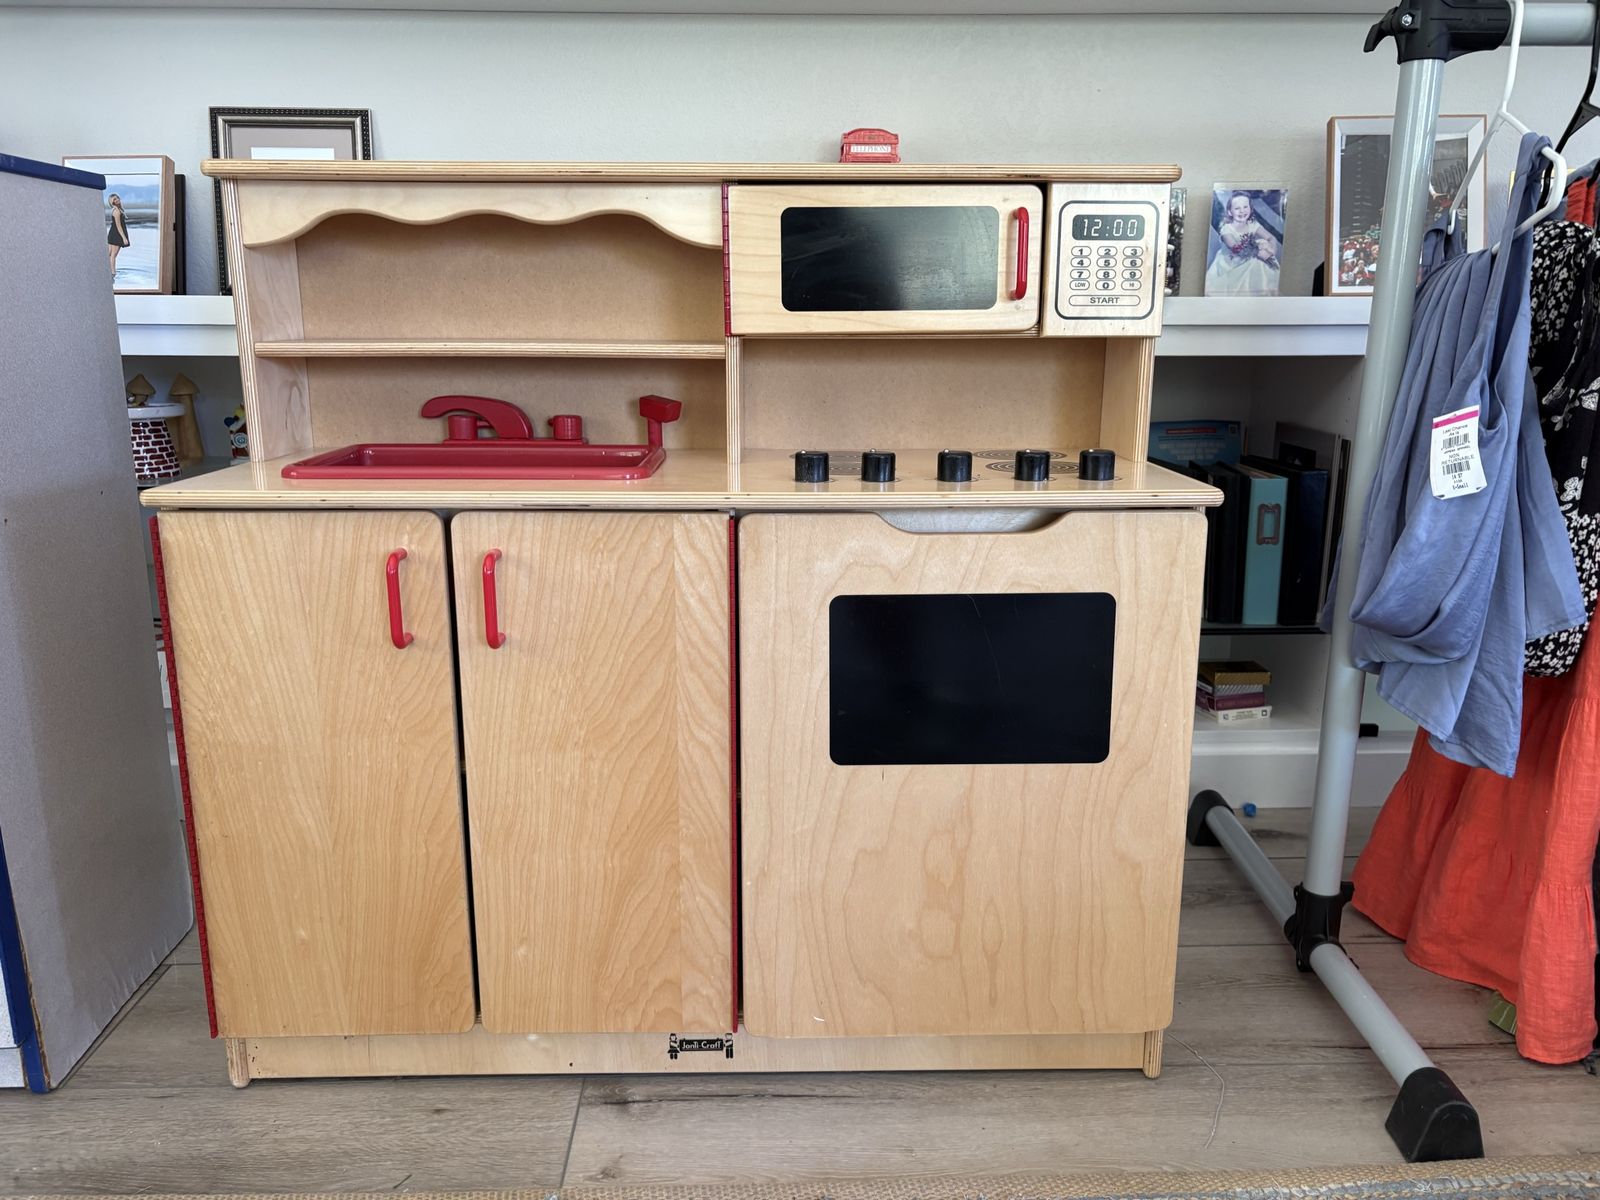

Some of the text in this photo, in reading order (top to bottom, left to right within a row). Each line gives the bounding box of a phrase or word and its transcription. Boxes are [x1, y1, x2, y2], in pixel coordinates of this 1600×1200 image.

[1082, 219, 1138, 237] 12:00
[1129, 271, 1136, 279] 9
[1441, 454, 1474, 465] RETURNABLE
